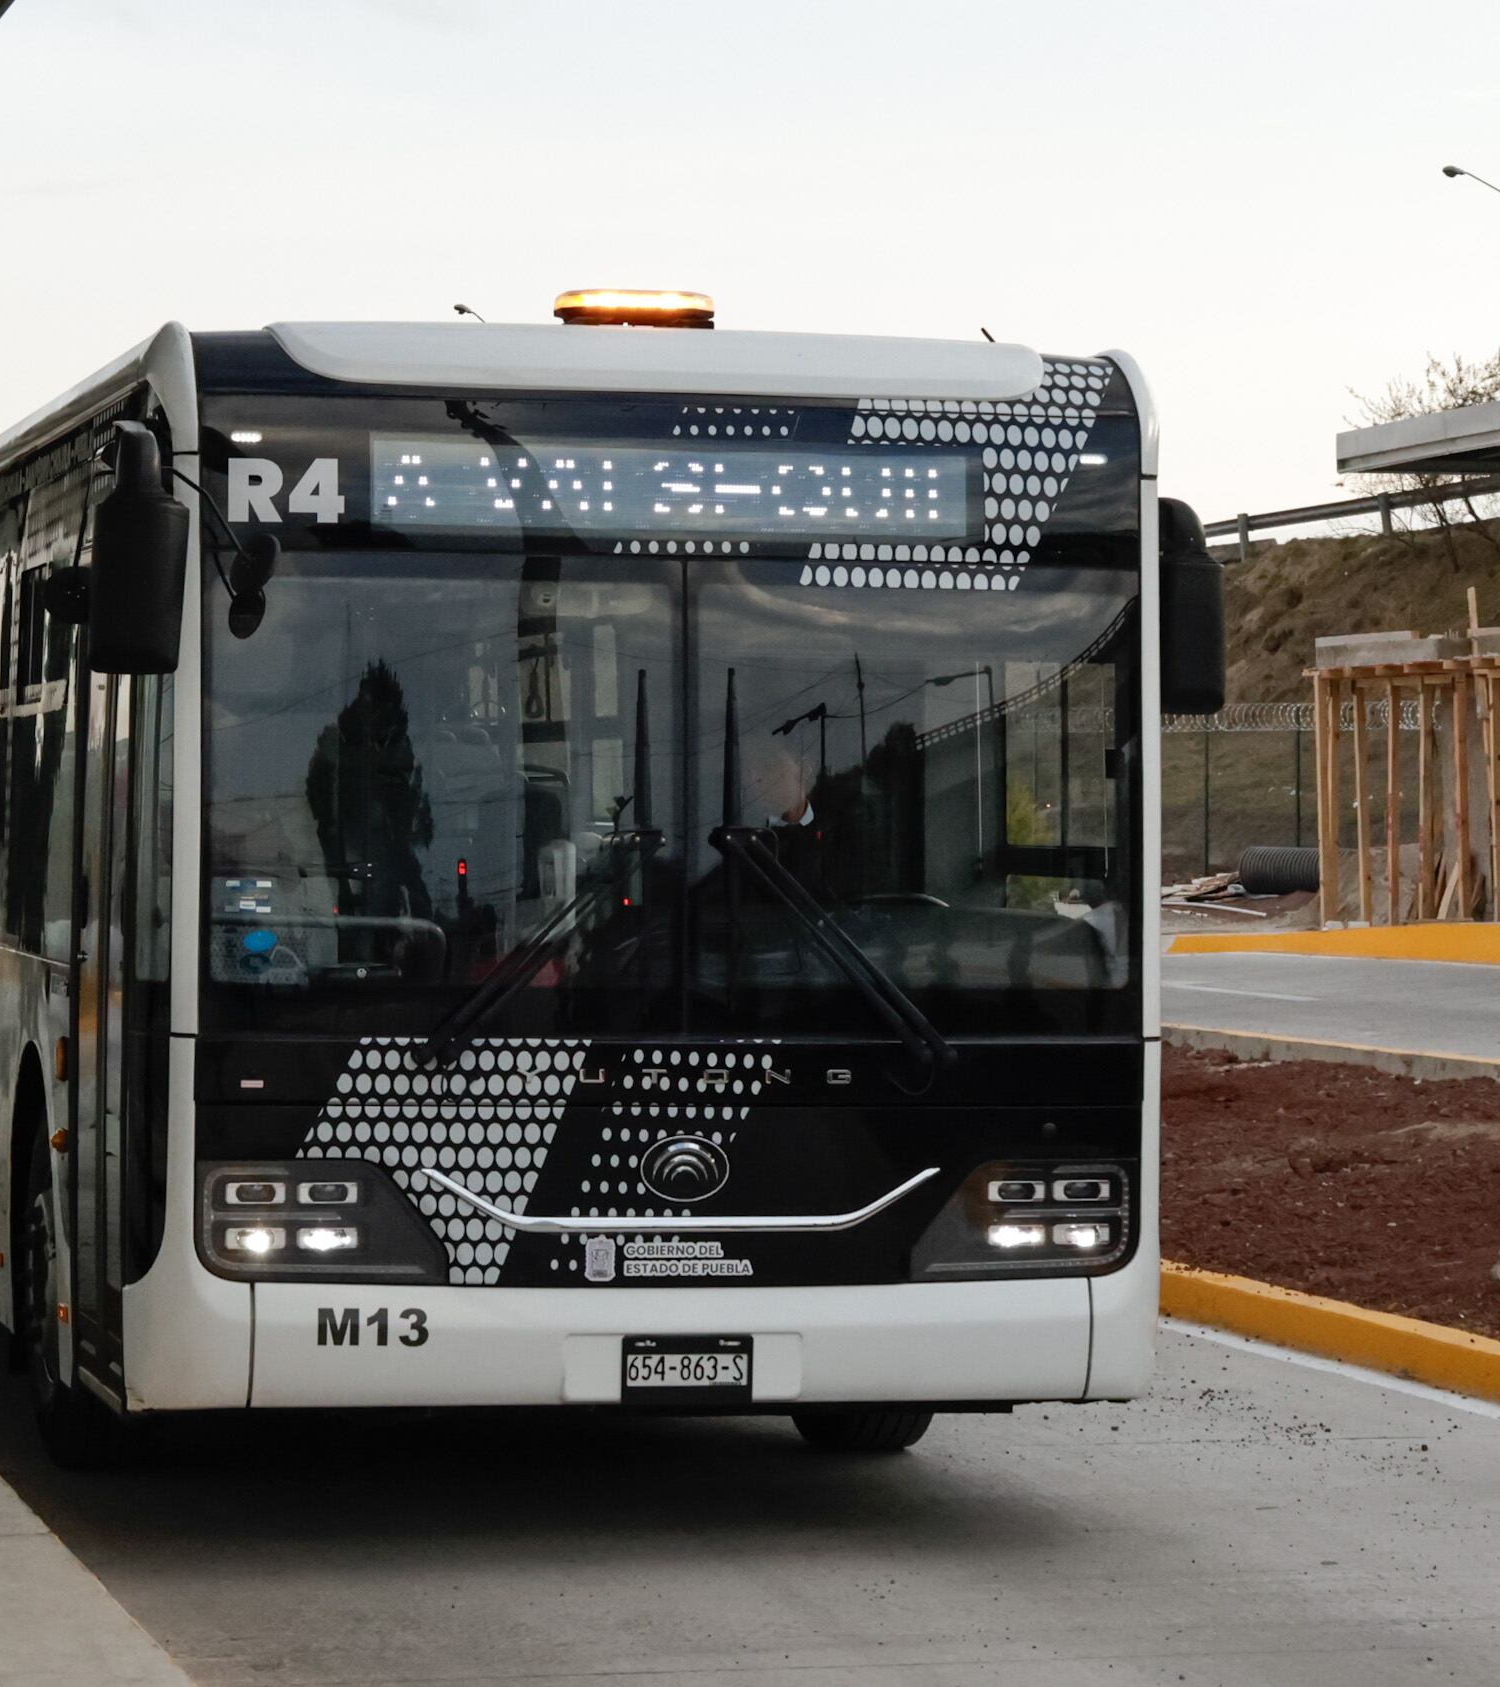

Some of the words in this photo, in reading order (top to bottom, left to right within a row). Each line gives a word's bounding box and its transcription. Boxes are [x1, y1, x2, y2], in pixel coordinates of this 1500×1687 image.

[227, 457, 345, 523] R4
[516, 1068, 852, 1084] YUTONG
[625, 1244, 696, 1256] GOBIERNO
[699, 1244, 722, 1256] DEL
[625, 1262, 679, 1275] ESTADO
[682, 1262, 699, 1275] DE
[702, 1262, 751, 1275] PUEBLA
[317, 1307, 429, 1347] M13
[628, 1354, 744, 1381] 654-863-S
